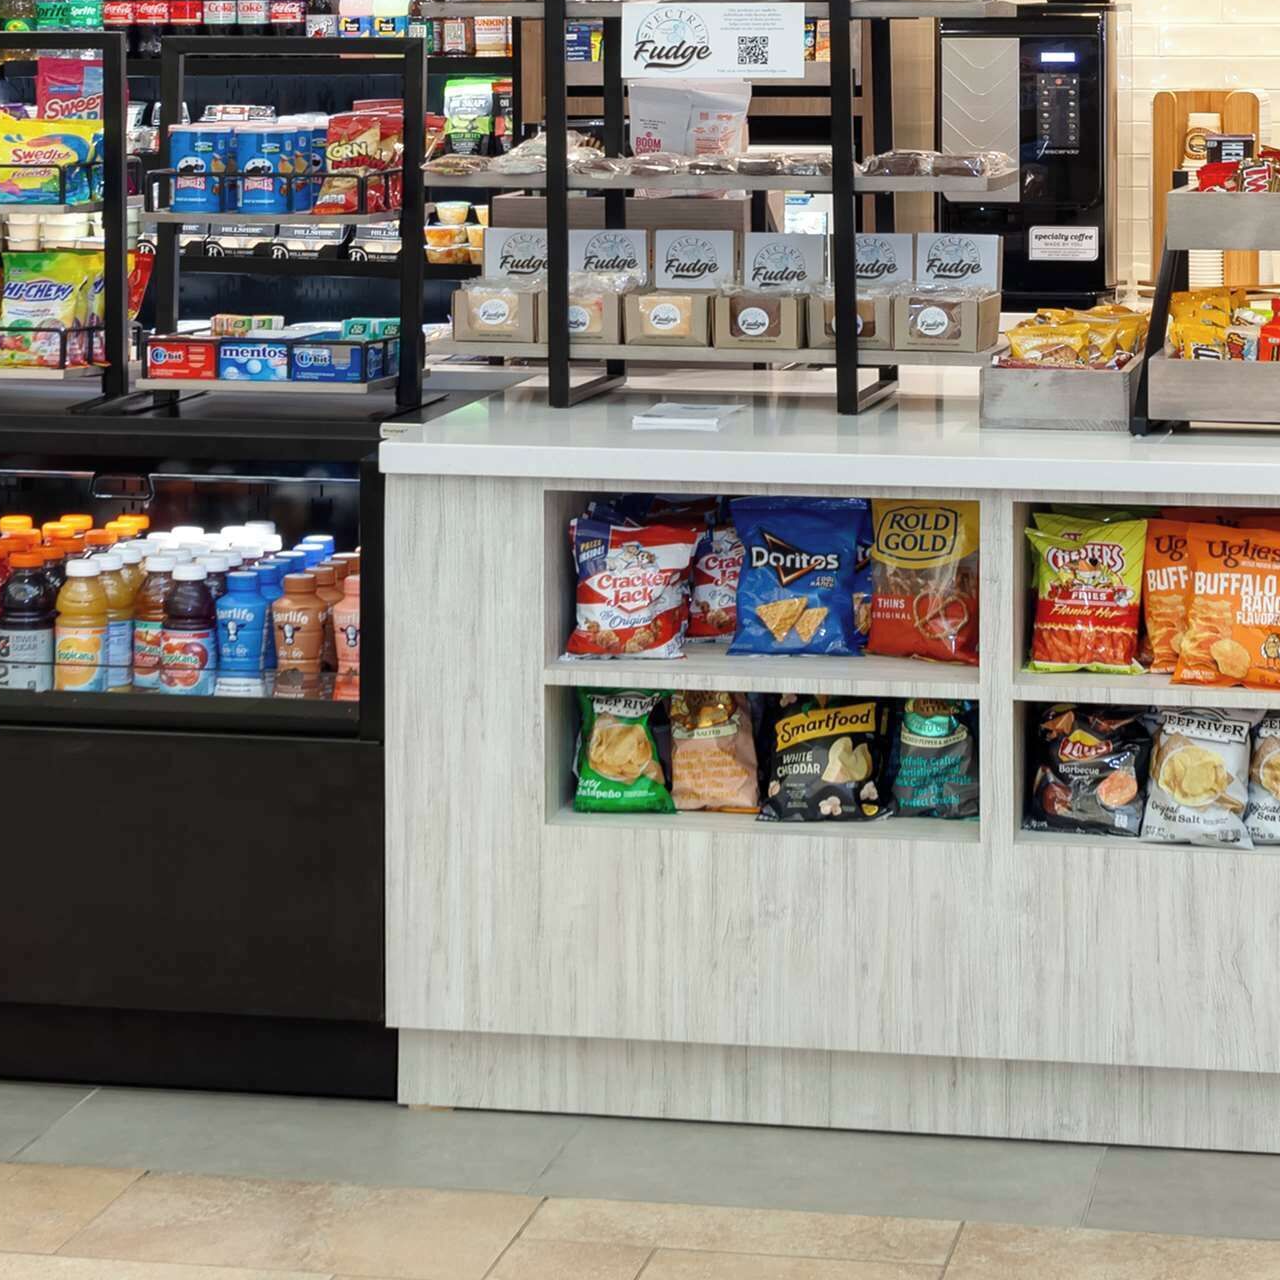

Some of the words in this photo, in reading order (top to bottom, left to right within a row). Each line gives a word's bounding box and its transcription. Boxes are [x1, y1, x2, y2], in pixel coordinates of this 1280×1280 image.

[633, 39, 713, 61] Fudge
[583, 254, 638, 271] Fudge
[664, 257, 719, 275] Fudge
[855, 258, 898, 276] udge
[925, 258, 982, 275] Fudge
[3, 281, 74, 302] HI-CHEW
[222, 345, 288, 359] mentos
[888, 512, 950, 532] ROLD
[884, 533, 948, 553] GOLD
[751, 545, 839, 570] Doritos
[597, 571, 671, 590] Cracker
[1194, 571, 1278, 597] BUFFALO
[606, 587, 654, 608] Jack
[877, 597, 906, 609] THINS
[780, 709, 871, 743] Smartfood
[1196, 720, 1245, 738] RIVER
[782, 751, 813, 764] WHITE
[777, 763, 821, 778] CHEDDAR
[1178, 814, 1200, 824] Salt
